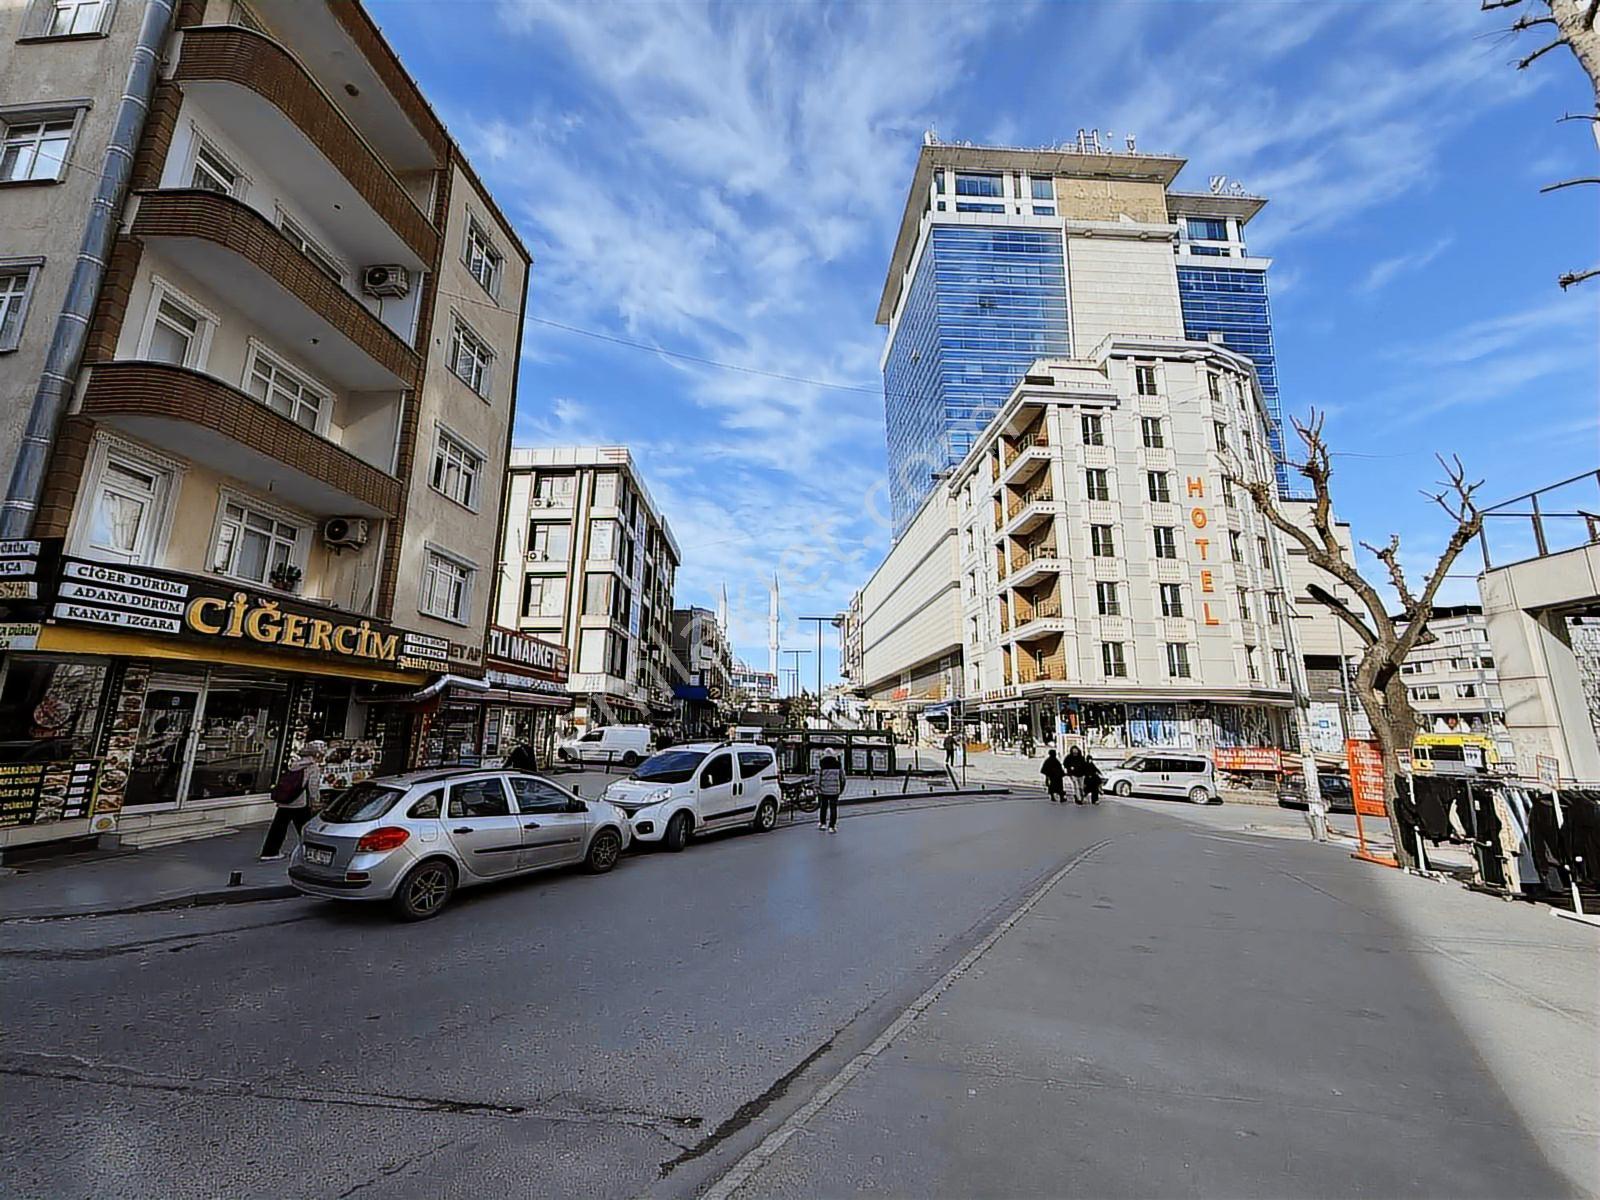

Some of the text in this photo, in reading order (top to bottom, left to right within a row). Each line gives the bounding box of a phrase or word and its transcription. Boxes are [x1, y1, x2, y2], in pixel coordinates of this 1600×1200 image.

[1186, 474, 1220, 626] HOTEL
[73, 586, 181, 612] ADANA DÜRÜM
[130, 575, 183, 594] DÜRÜM
[67, 606, 175, 631] KANAT IZGARA
[184, 591, 399, 661] CİĞERCİM
[511, 636, 556, 670] MARKET
